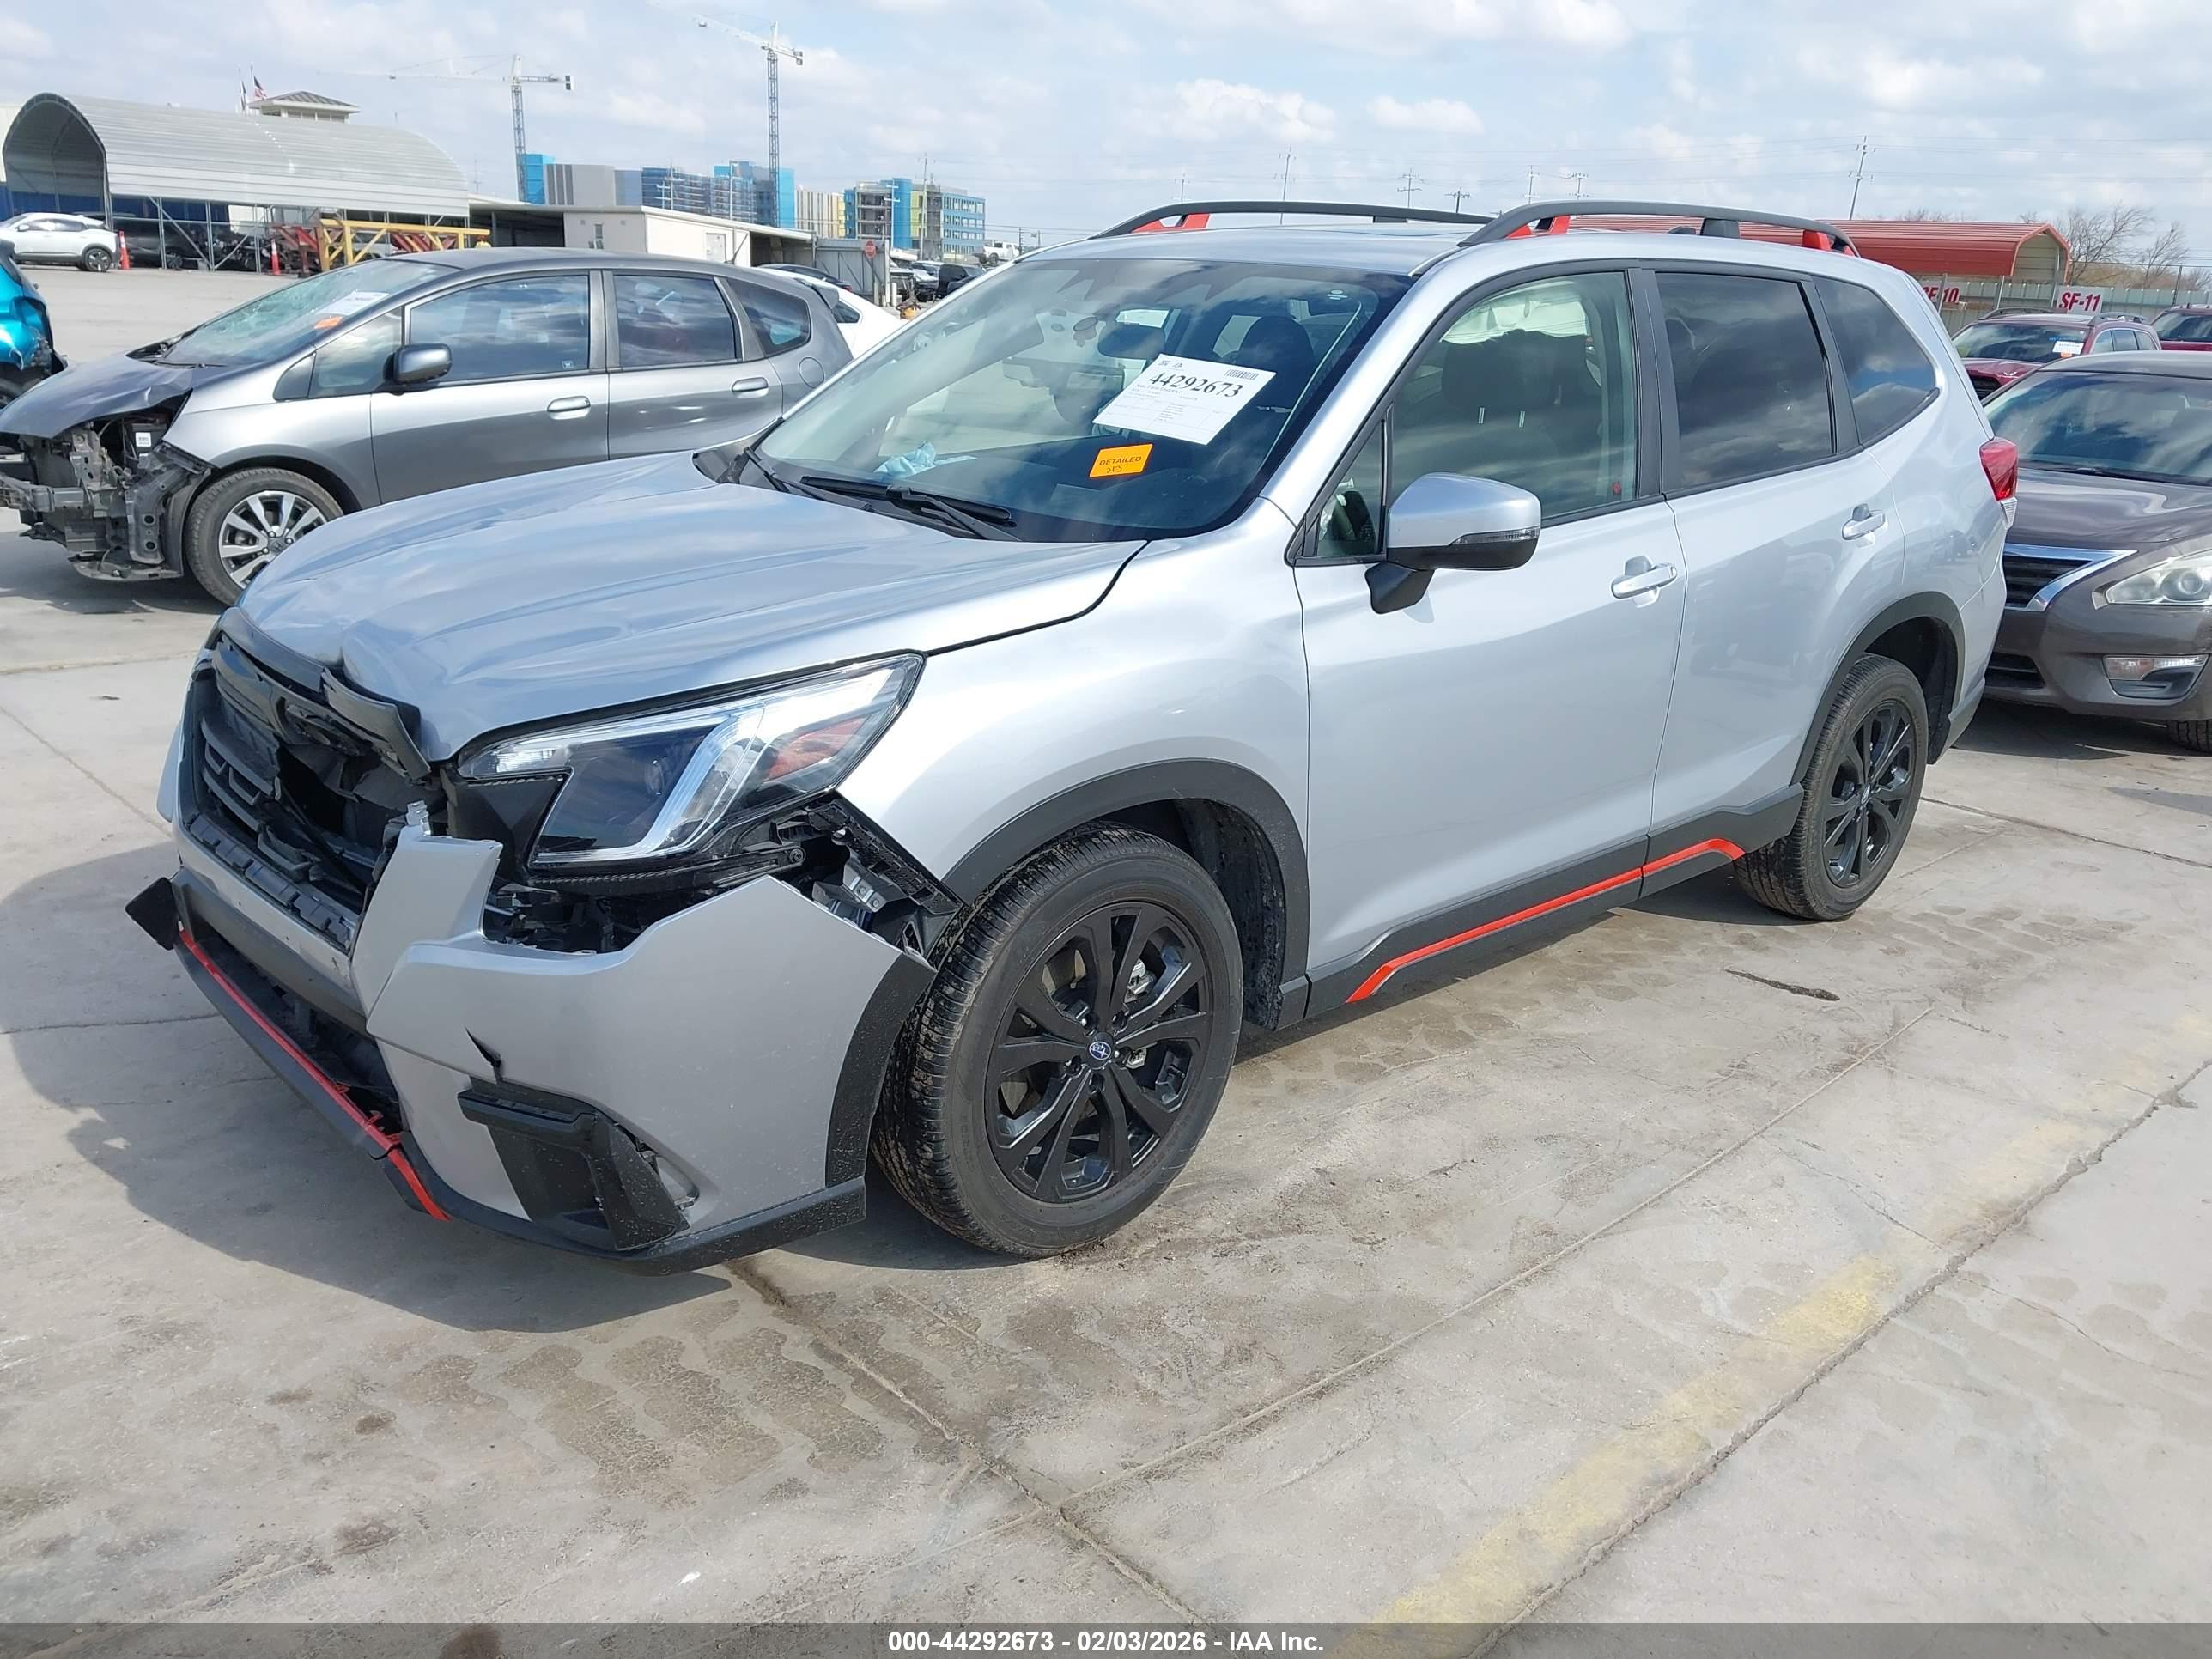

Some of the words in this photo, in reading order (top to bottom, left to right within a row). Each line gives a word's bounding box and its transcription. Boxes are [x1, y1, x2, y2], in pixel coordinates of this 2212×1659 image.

[2058, 291, 2102, 312] SF-11
[1149, 371, 1243, 398] 44292673
[1099, 456, 1142, 465] DETAILED
